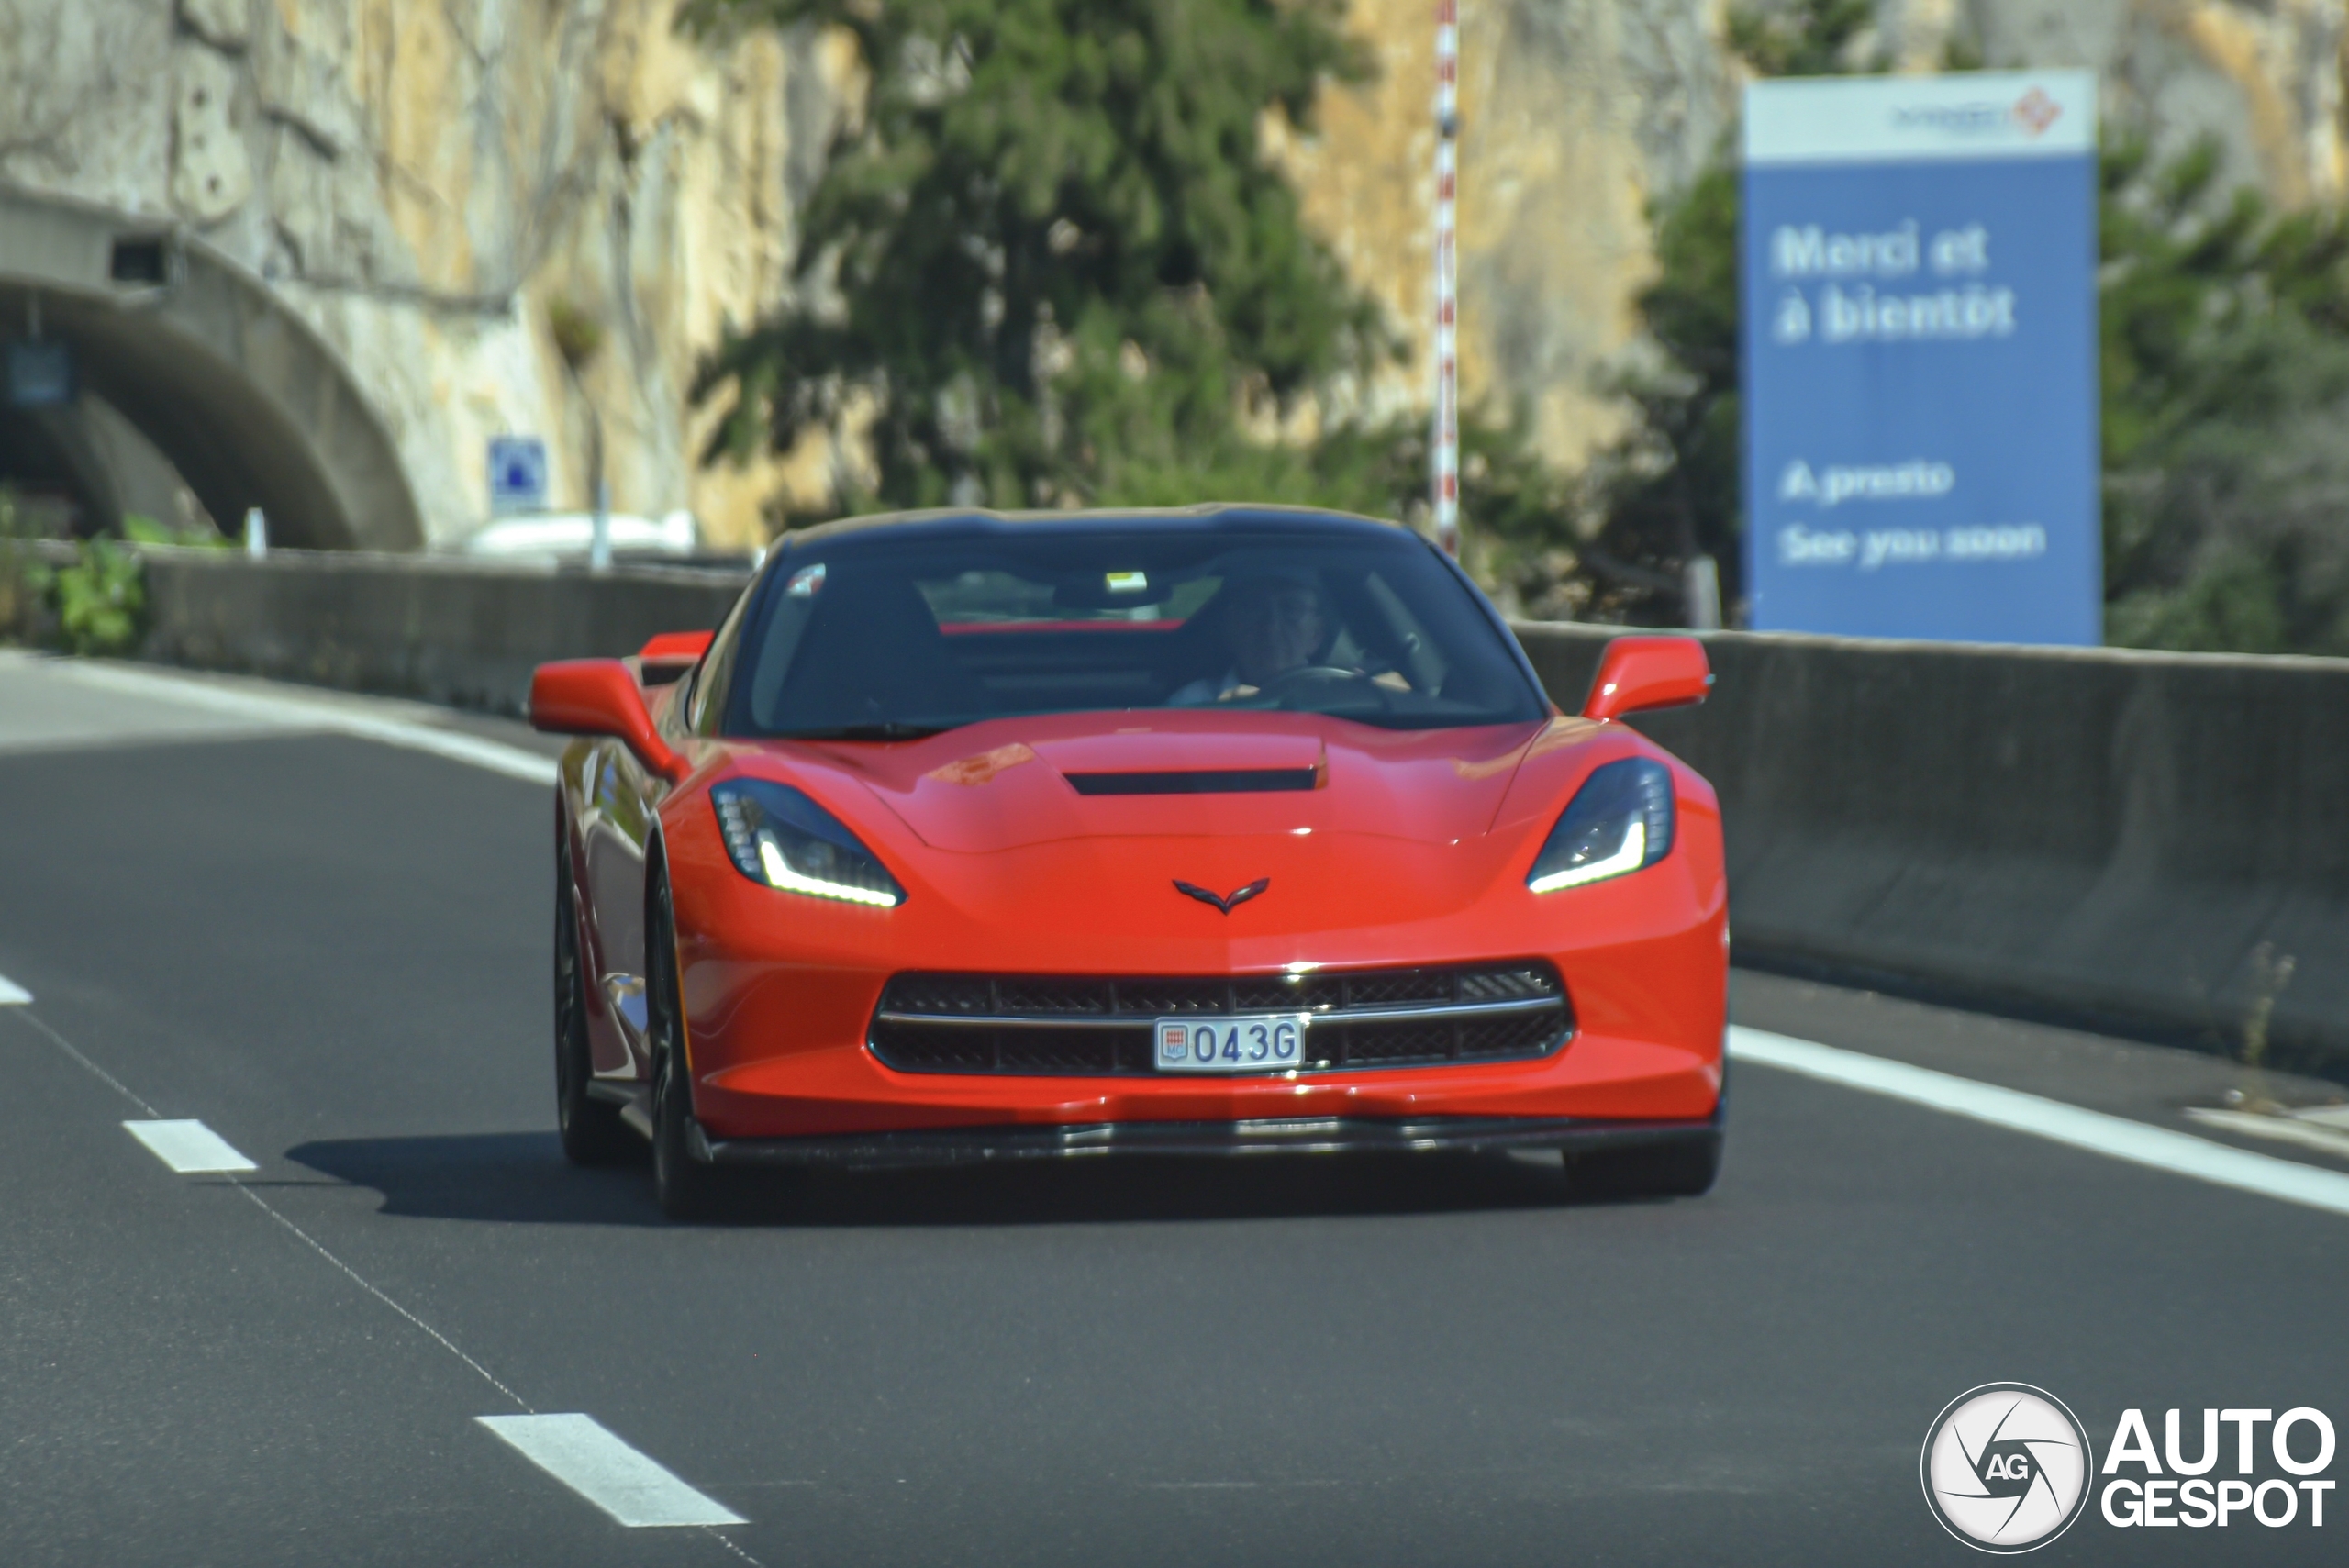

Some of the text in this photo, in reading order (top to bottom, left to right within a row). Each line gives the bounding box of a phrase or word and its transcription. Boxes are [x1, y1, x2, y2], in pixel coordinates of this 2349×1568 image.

[1774, 219, 1989, 277] Merci et
[1775, 283, 2014, 345] à bientôt
[1781, 460, 1954, 506] A presto
[1780, 526, 2048, 570] See you soon
[1195, 1023, 1296, 1062] 043G
